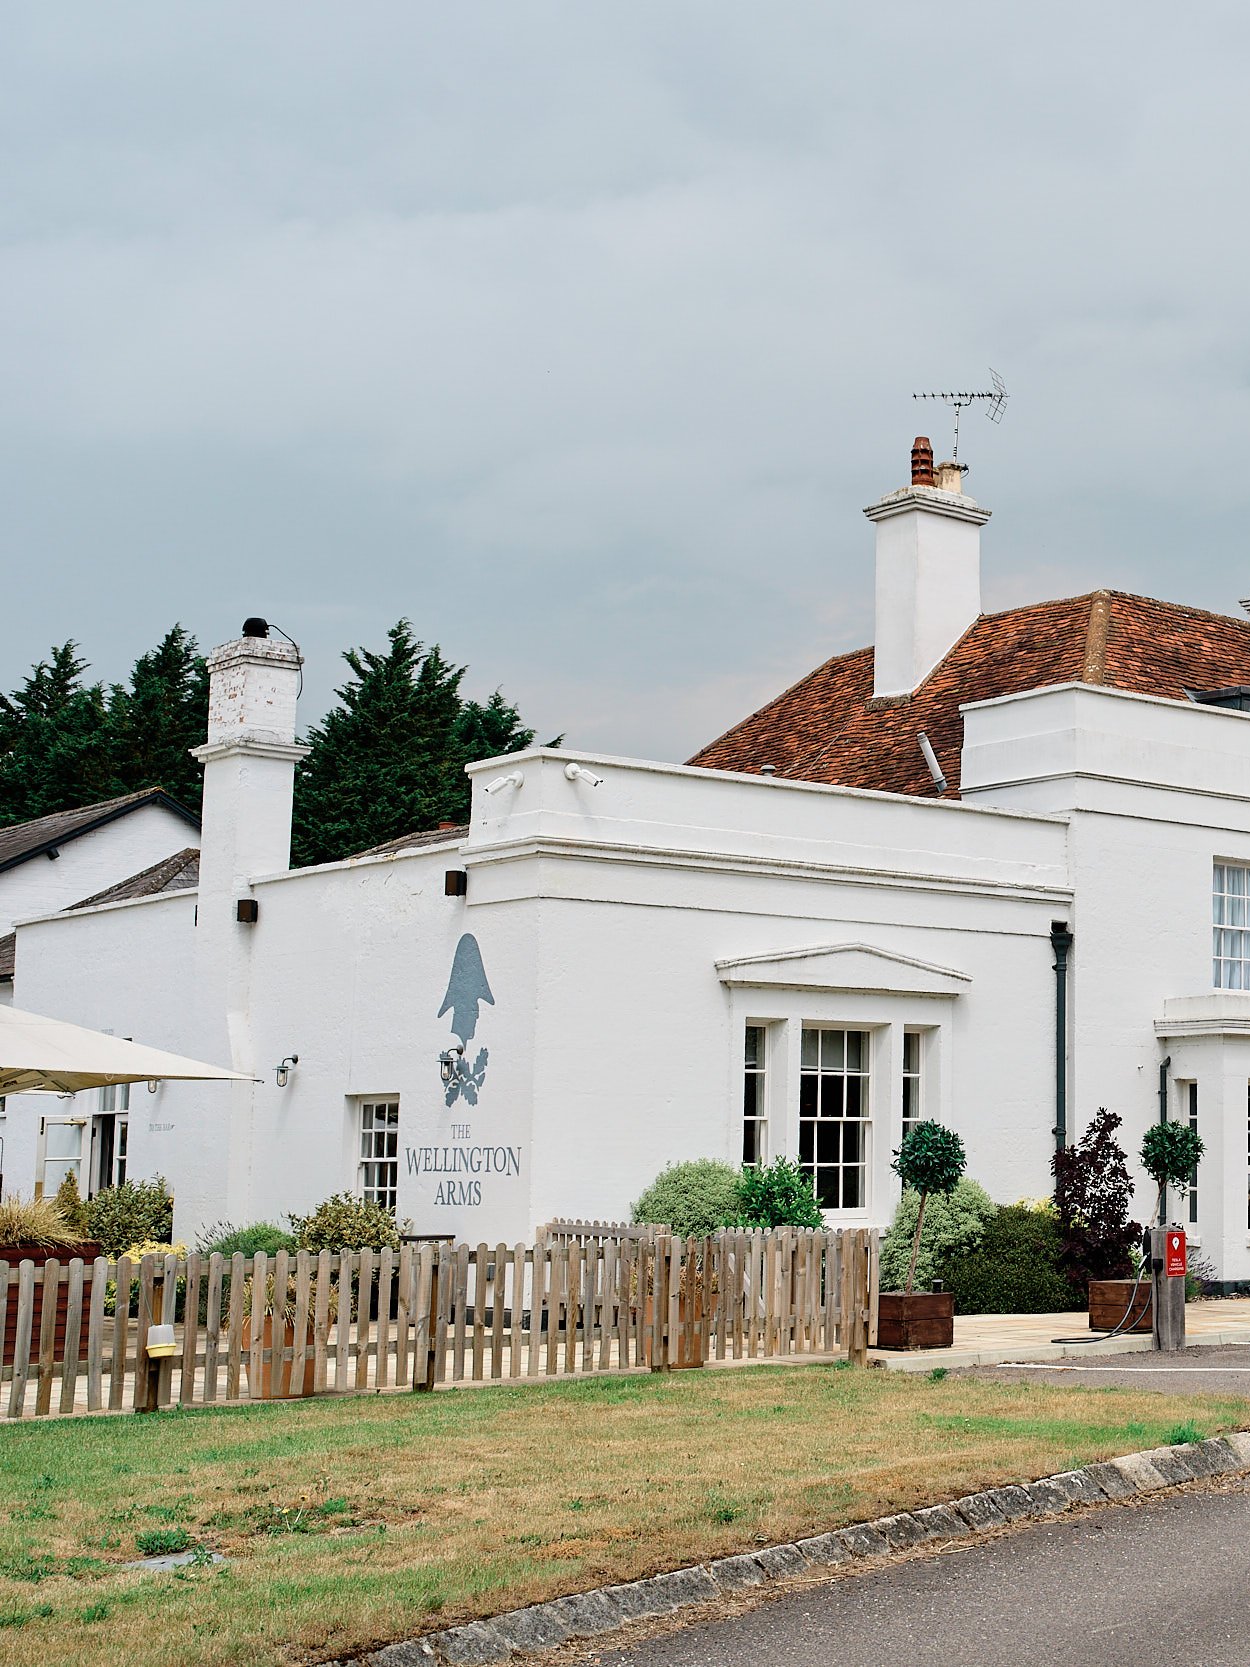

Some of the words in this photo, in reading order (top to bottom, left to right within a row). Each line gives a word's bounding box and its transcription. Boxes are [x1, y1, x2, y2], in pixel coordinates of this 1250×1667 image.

[451, 1124, 471, 1139] THE
[405, 1146, 522, 1176] WELLINGTON
[434, 1180, 482, 1206] ARMS
